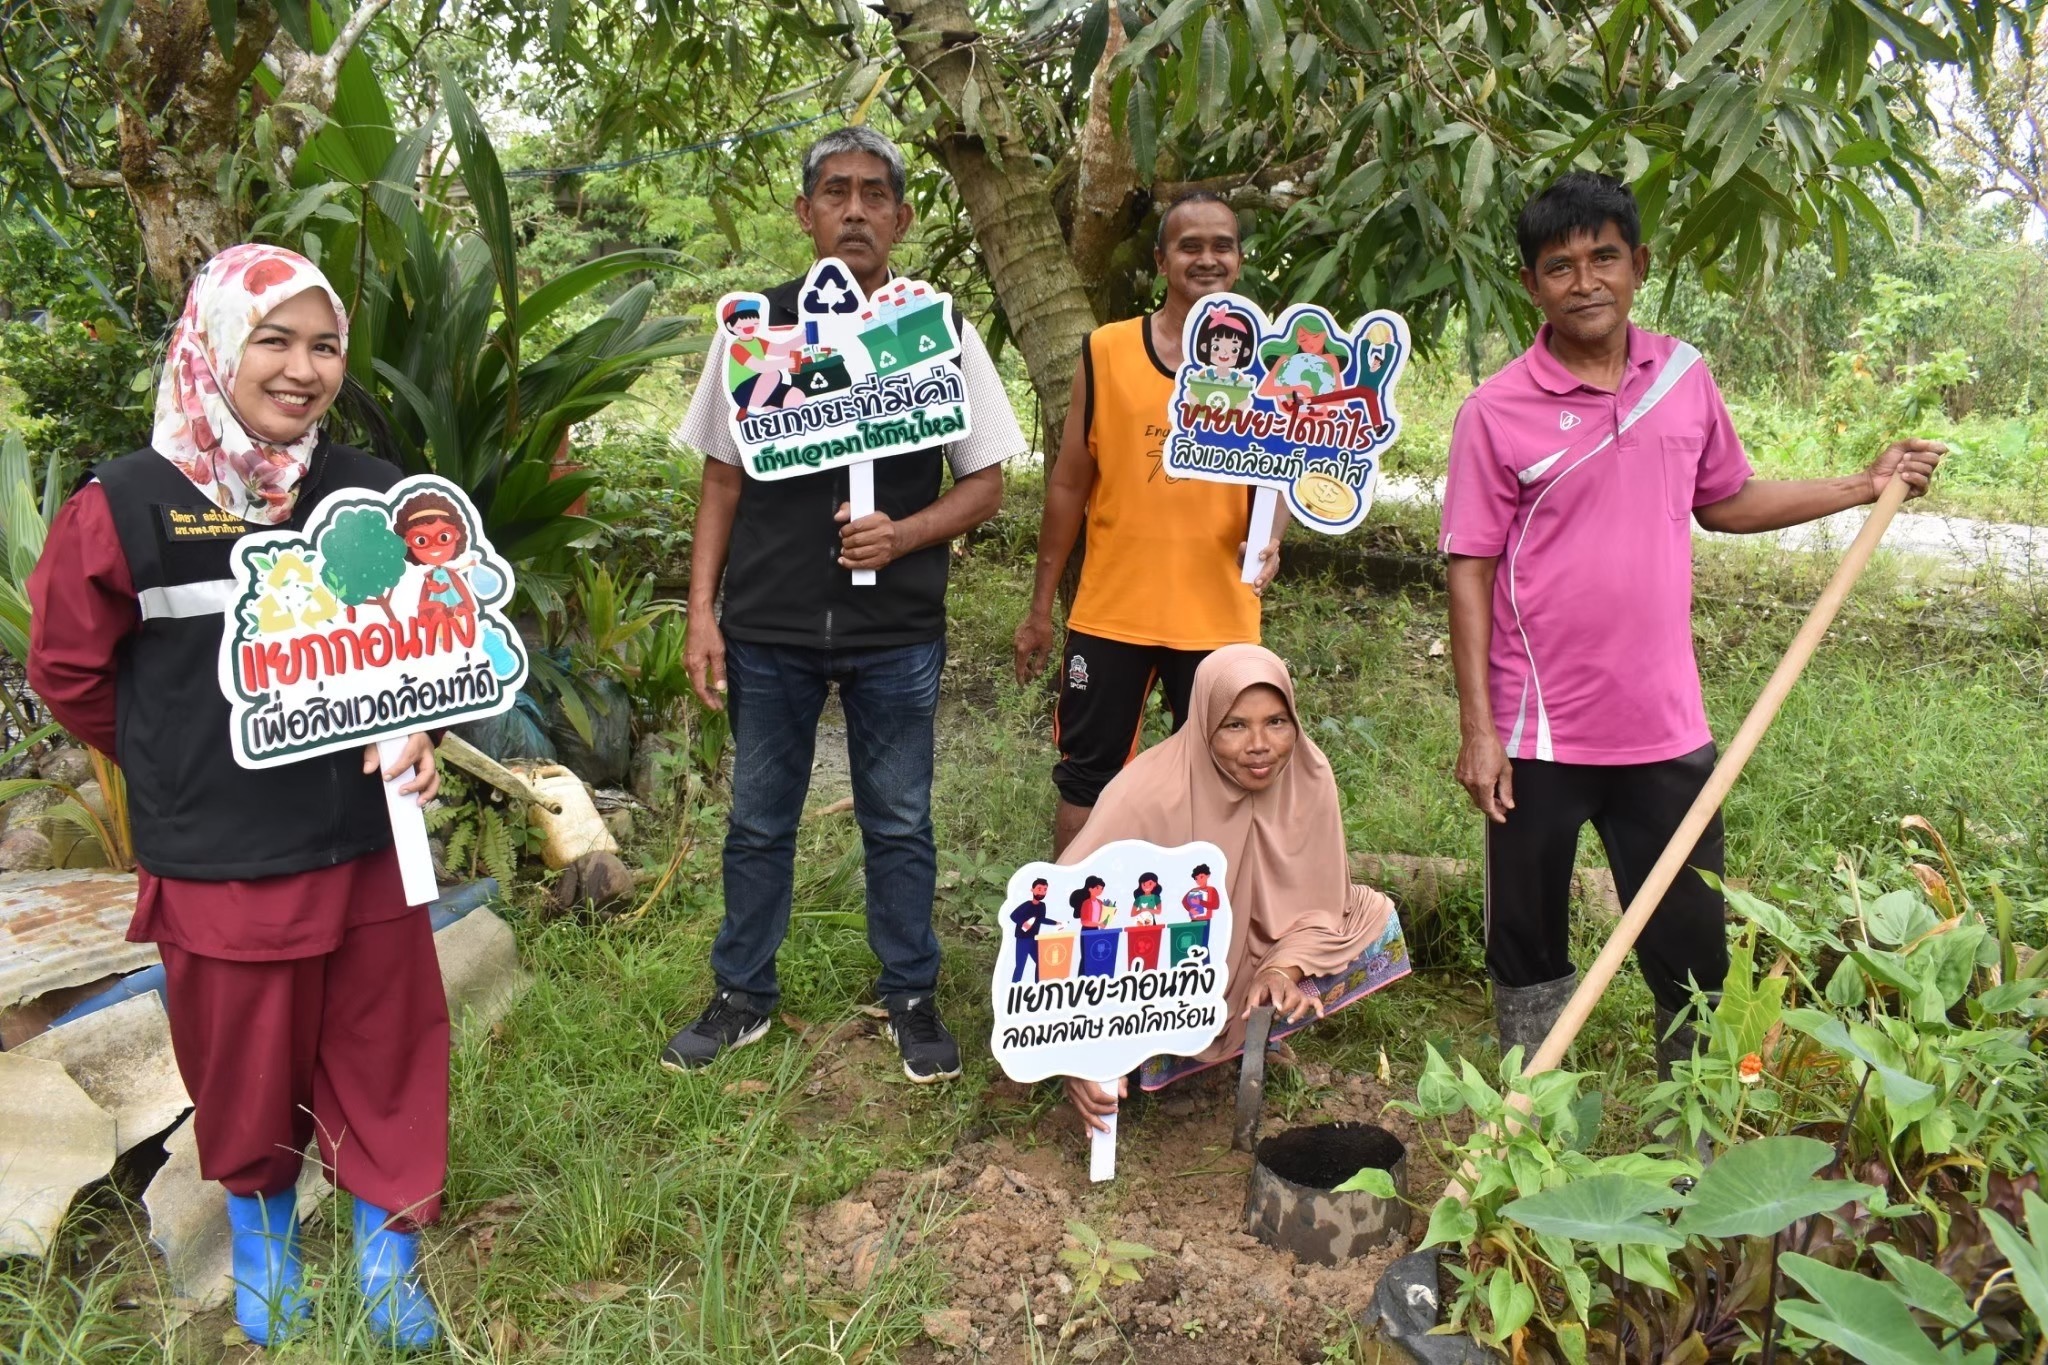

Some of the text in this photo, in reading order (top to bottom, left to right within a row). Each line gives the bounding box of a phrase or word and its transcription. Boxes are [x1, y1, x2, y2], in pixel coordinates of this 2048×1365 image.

[742, 367, 962, 442] แยกขยะที่มีค่า
[1180, 400, 1373, 450] ขายขยะได้กำไร
[1175, 430, 1304, 478] สิ่งแวดล้อมก็
[252, 652, 496, 748] เพื่อสิ่งแวดล้อมที่ดี
[1006, 948, 1216, 1015] แยกขยะก่อนทิ้ง
[1002, 1000, 1216, 1049] ลดมลพิษ ลดโลกร้อน
